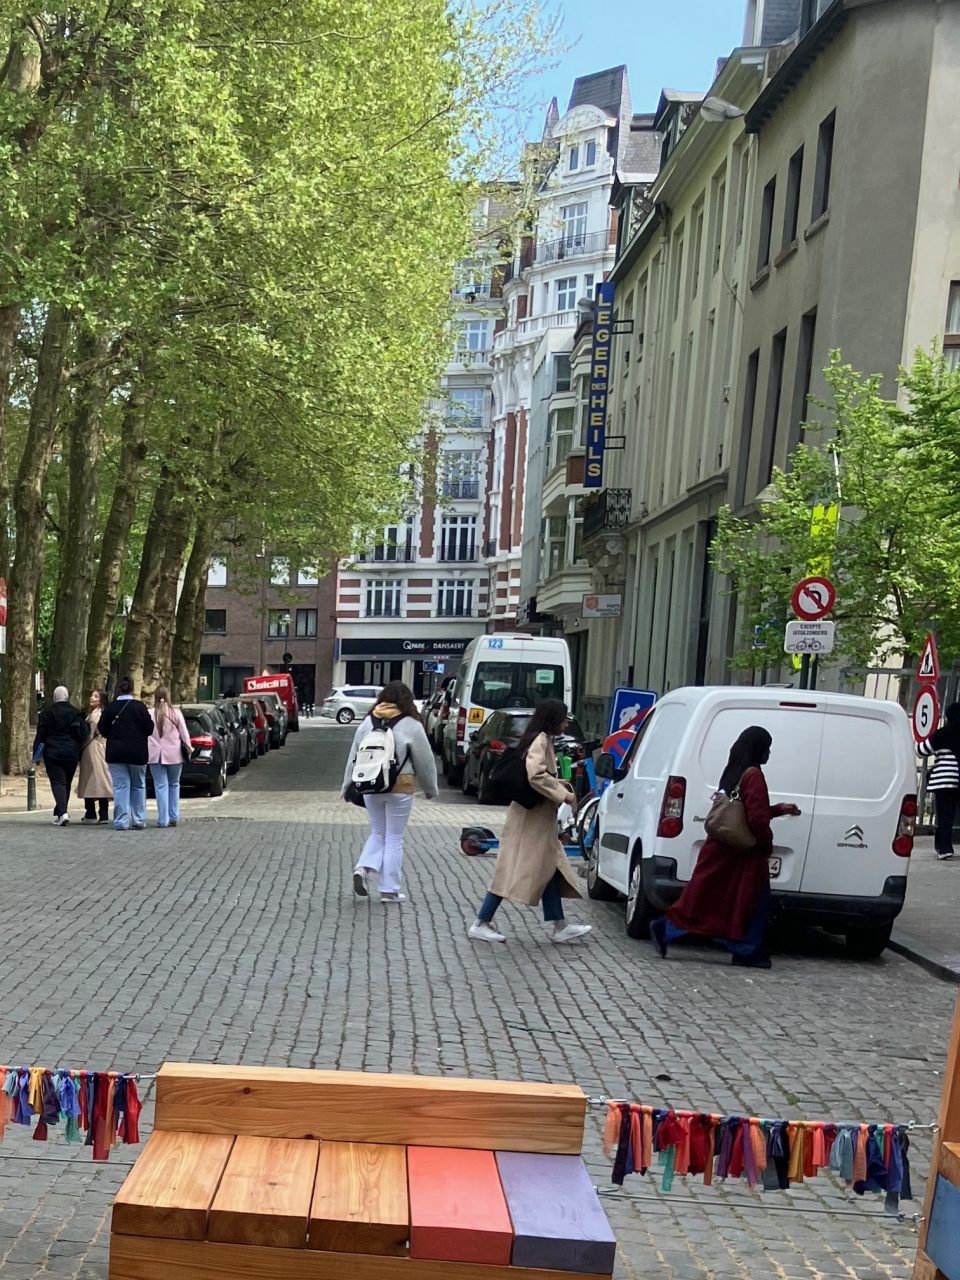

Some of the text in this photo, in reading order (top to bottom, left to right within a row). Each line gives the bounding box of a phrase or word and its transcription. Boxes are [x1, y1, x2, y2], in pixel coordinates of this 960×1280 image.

[593, 293, 611, 378] LEGER
[587, 395, 605, 476] HEILS
[488, 639, 503, 648] 123
[921, 705, 928, 727] 5
